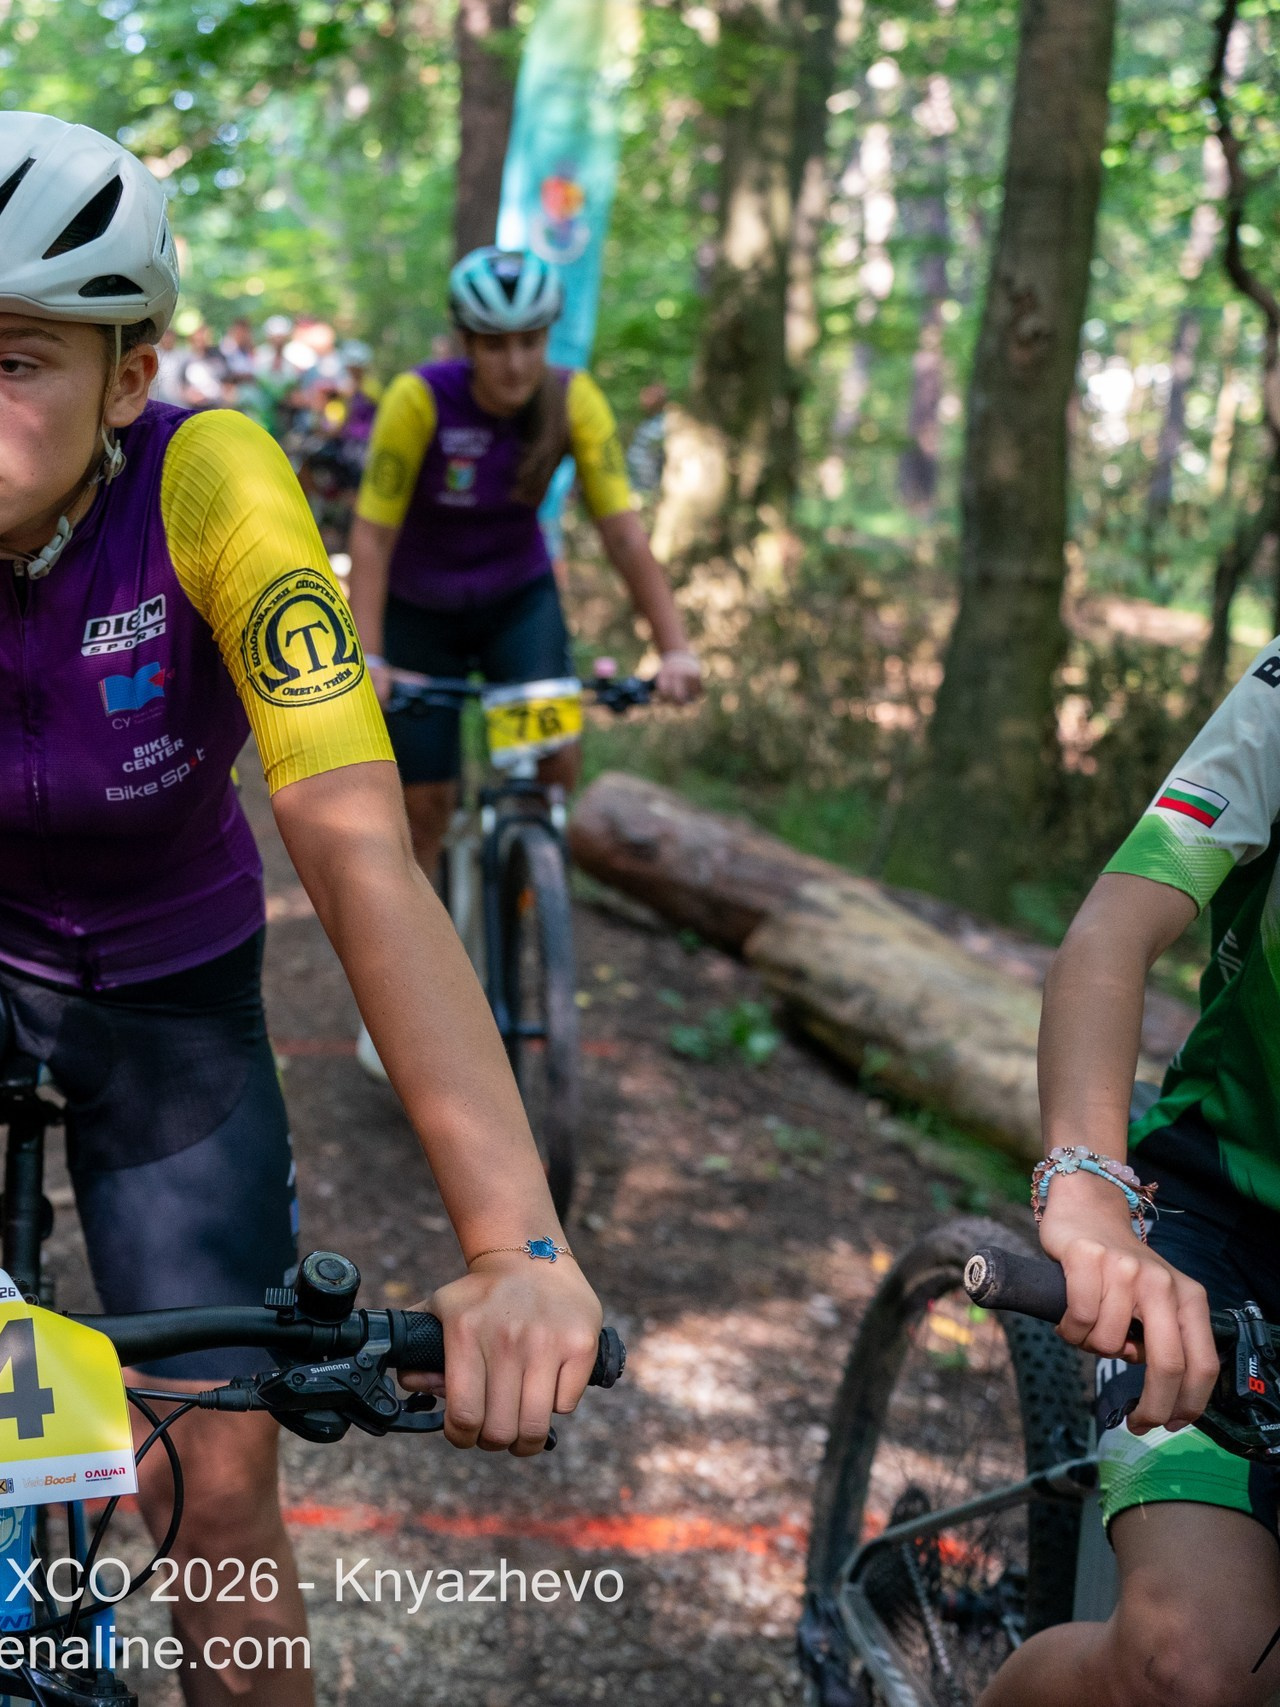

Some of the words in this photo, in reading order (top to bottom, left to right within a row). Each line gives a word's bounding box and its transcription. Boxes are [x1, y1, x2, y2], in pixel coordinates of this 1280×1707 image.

[89, 598, 163, 640] DIEM
[89, 625, 163, 653] SPORT
[122, 738, 185, 773] CENTER
[133, 734, 171, 758] BIKE
[106, 782, 158, 801] Bike
[310, 1363, 351, 1374] SHIMANO
